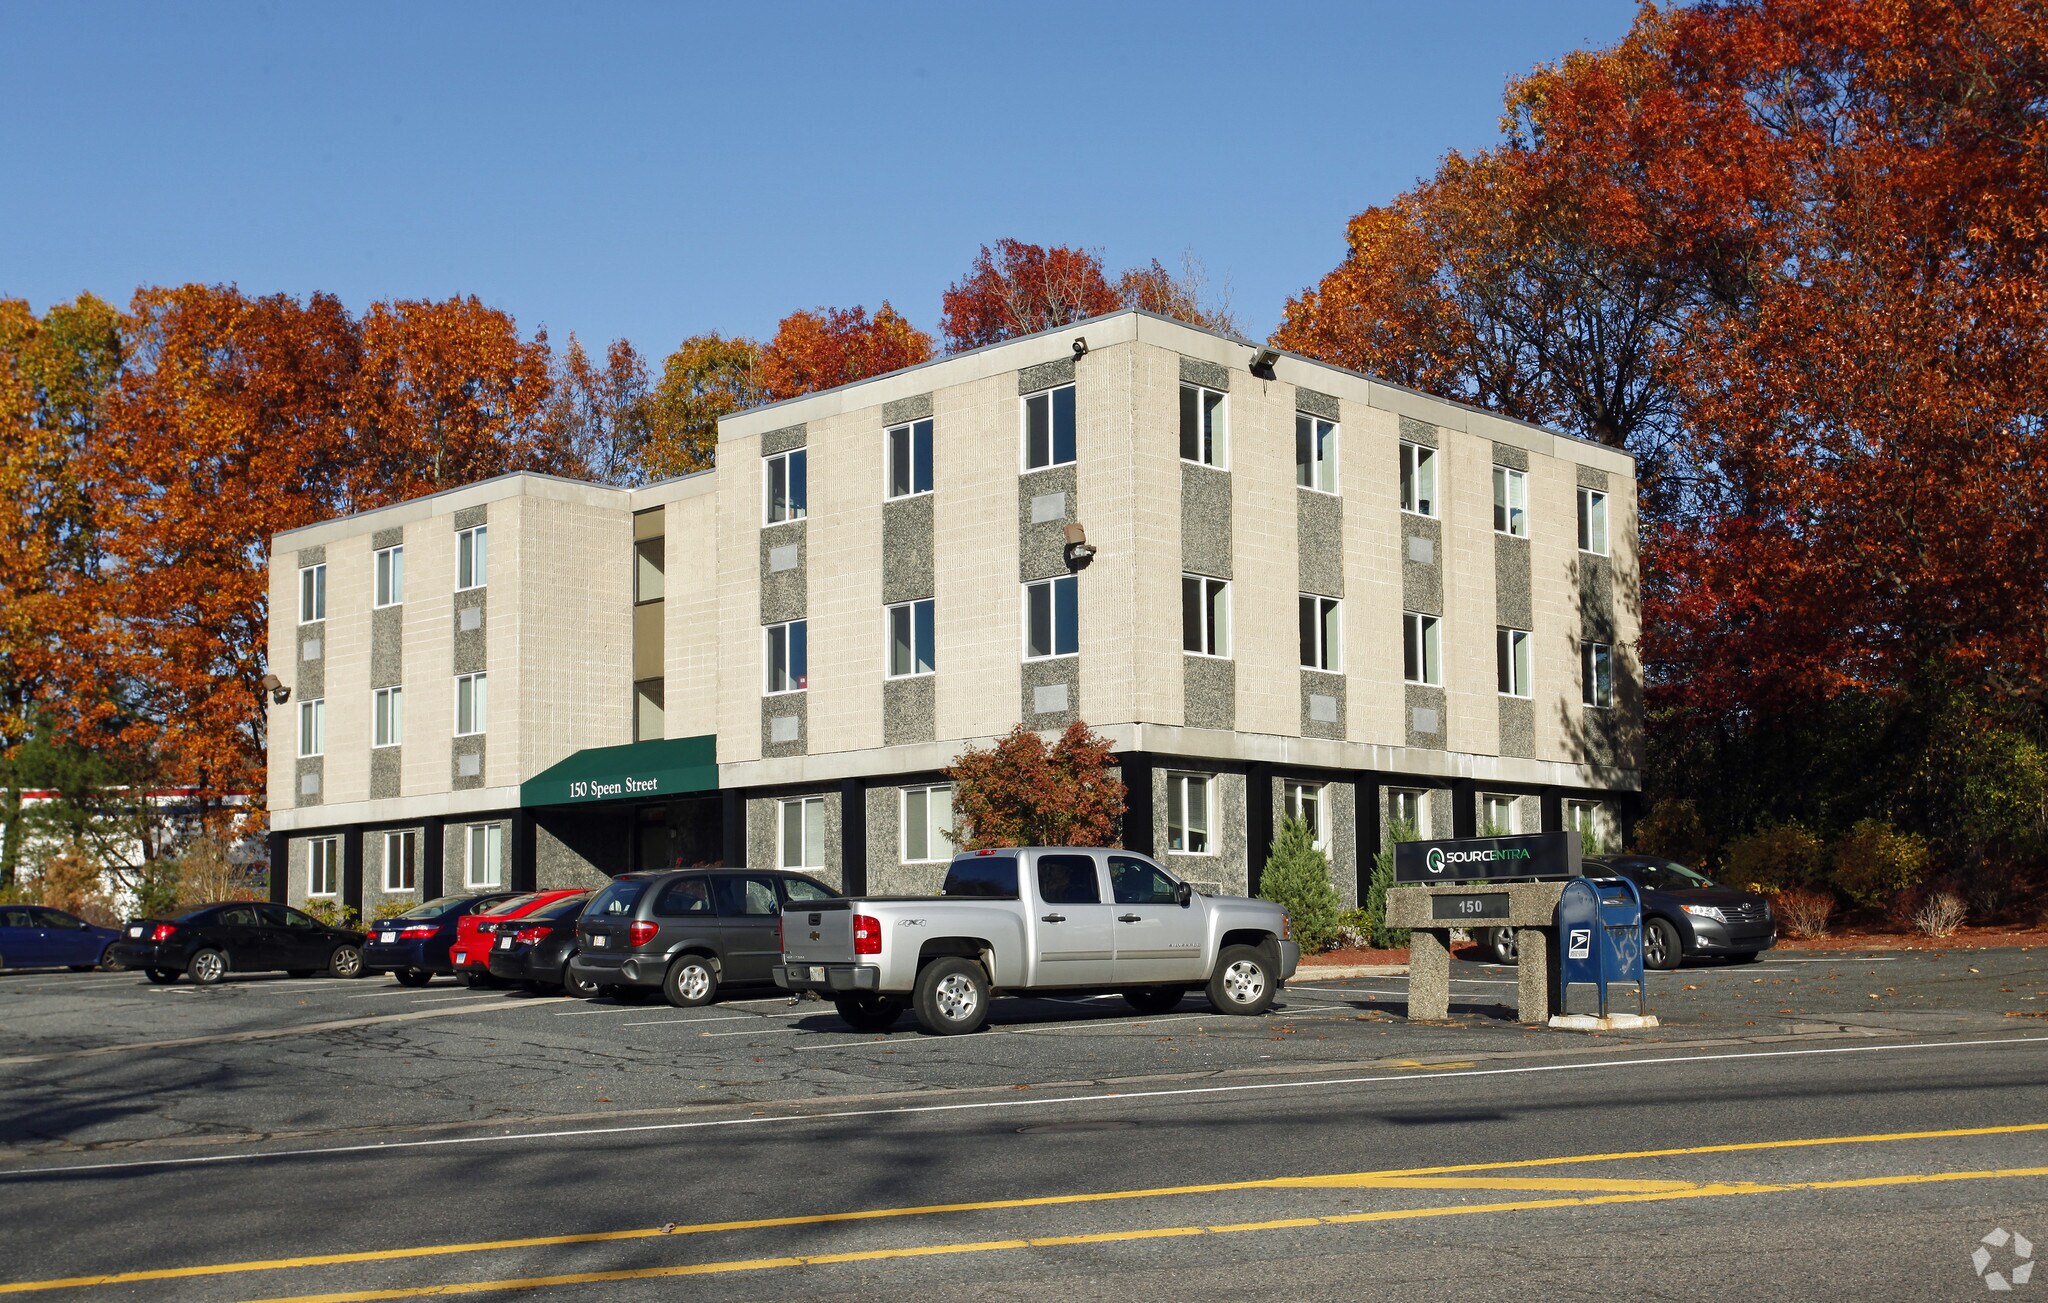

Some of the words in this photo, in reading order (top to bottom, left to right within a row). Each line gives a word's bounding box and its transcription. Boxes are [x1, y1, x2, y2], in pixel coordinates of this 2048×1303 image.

[570, 782, 587, 798] 150
[591, 780, 622, 798] Speen
[625, 777, 658, 792] Street
[1446, 848, 1531, 864] SOURCENTRA
[1458, 900, 1483, 913] 150
